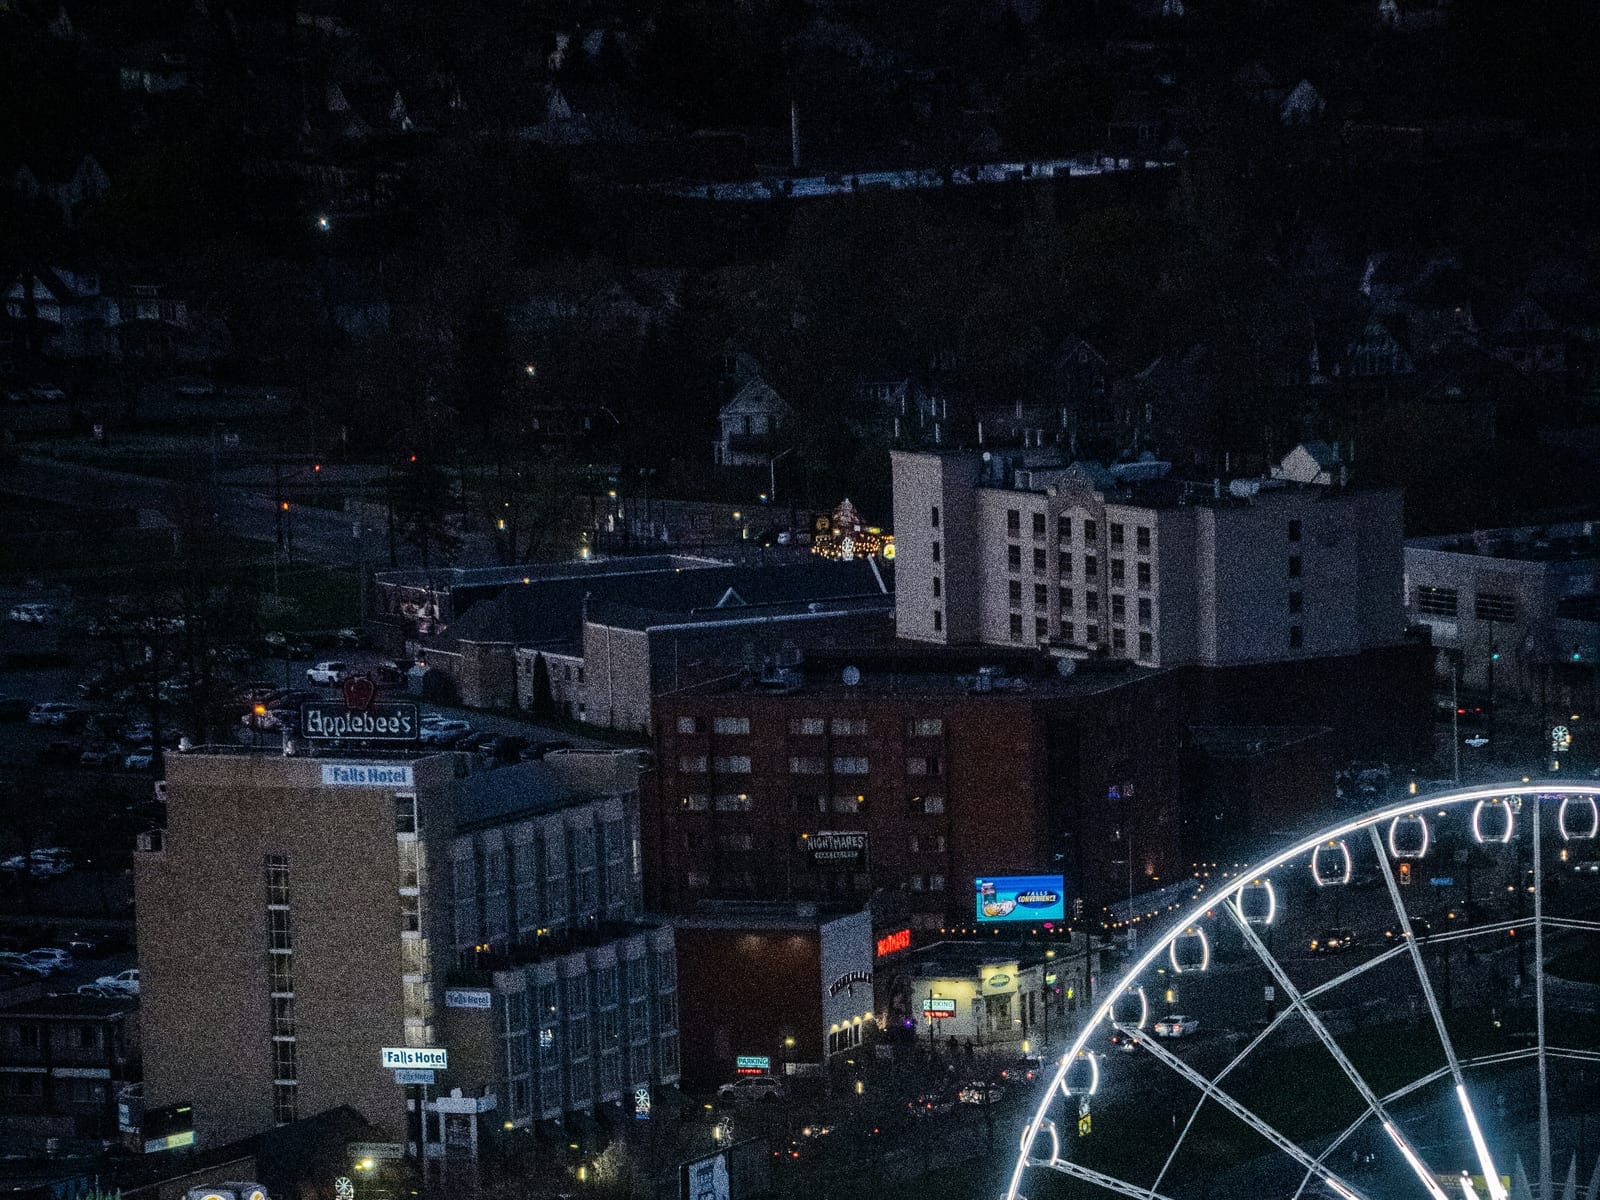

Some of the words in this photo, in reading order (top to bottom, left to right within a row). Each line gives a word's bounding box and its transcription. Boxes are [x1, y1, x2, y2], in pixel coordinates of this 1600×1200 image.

[307, 710, 412, 737] Applebee's
[332, 767, 366, 782] Falls
[367, 768, 406, 782] Hotel
[924, 1000, 953, 1008] PRKING
[387, 1051, 413, 1064] Falls
[415, 1052, 446, 1064] Hotel
